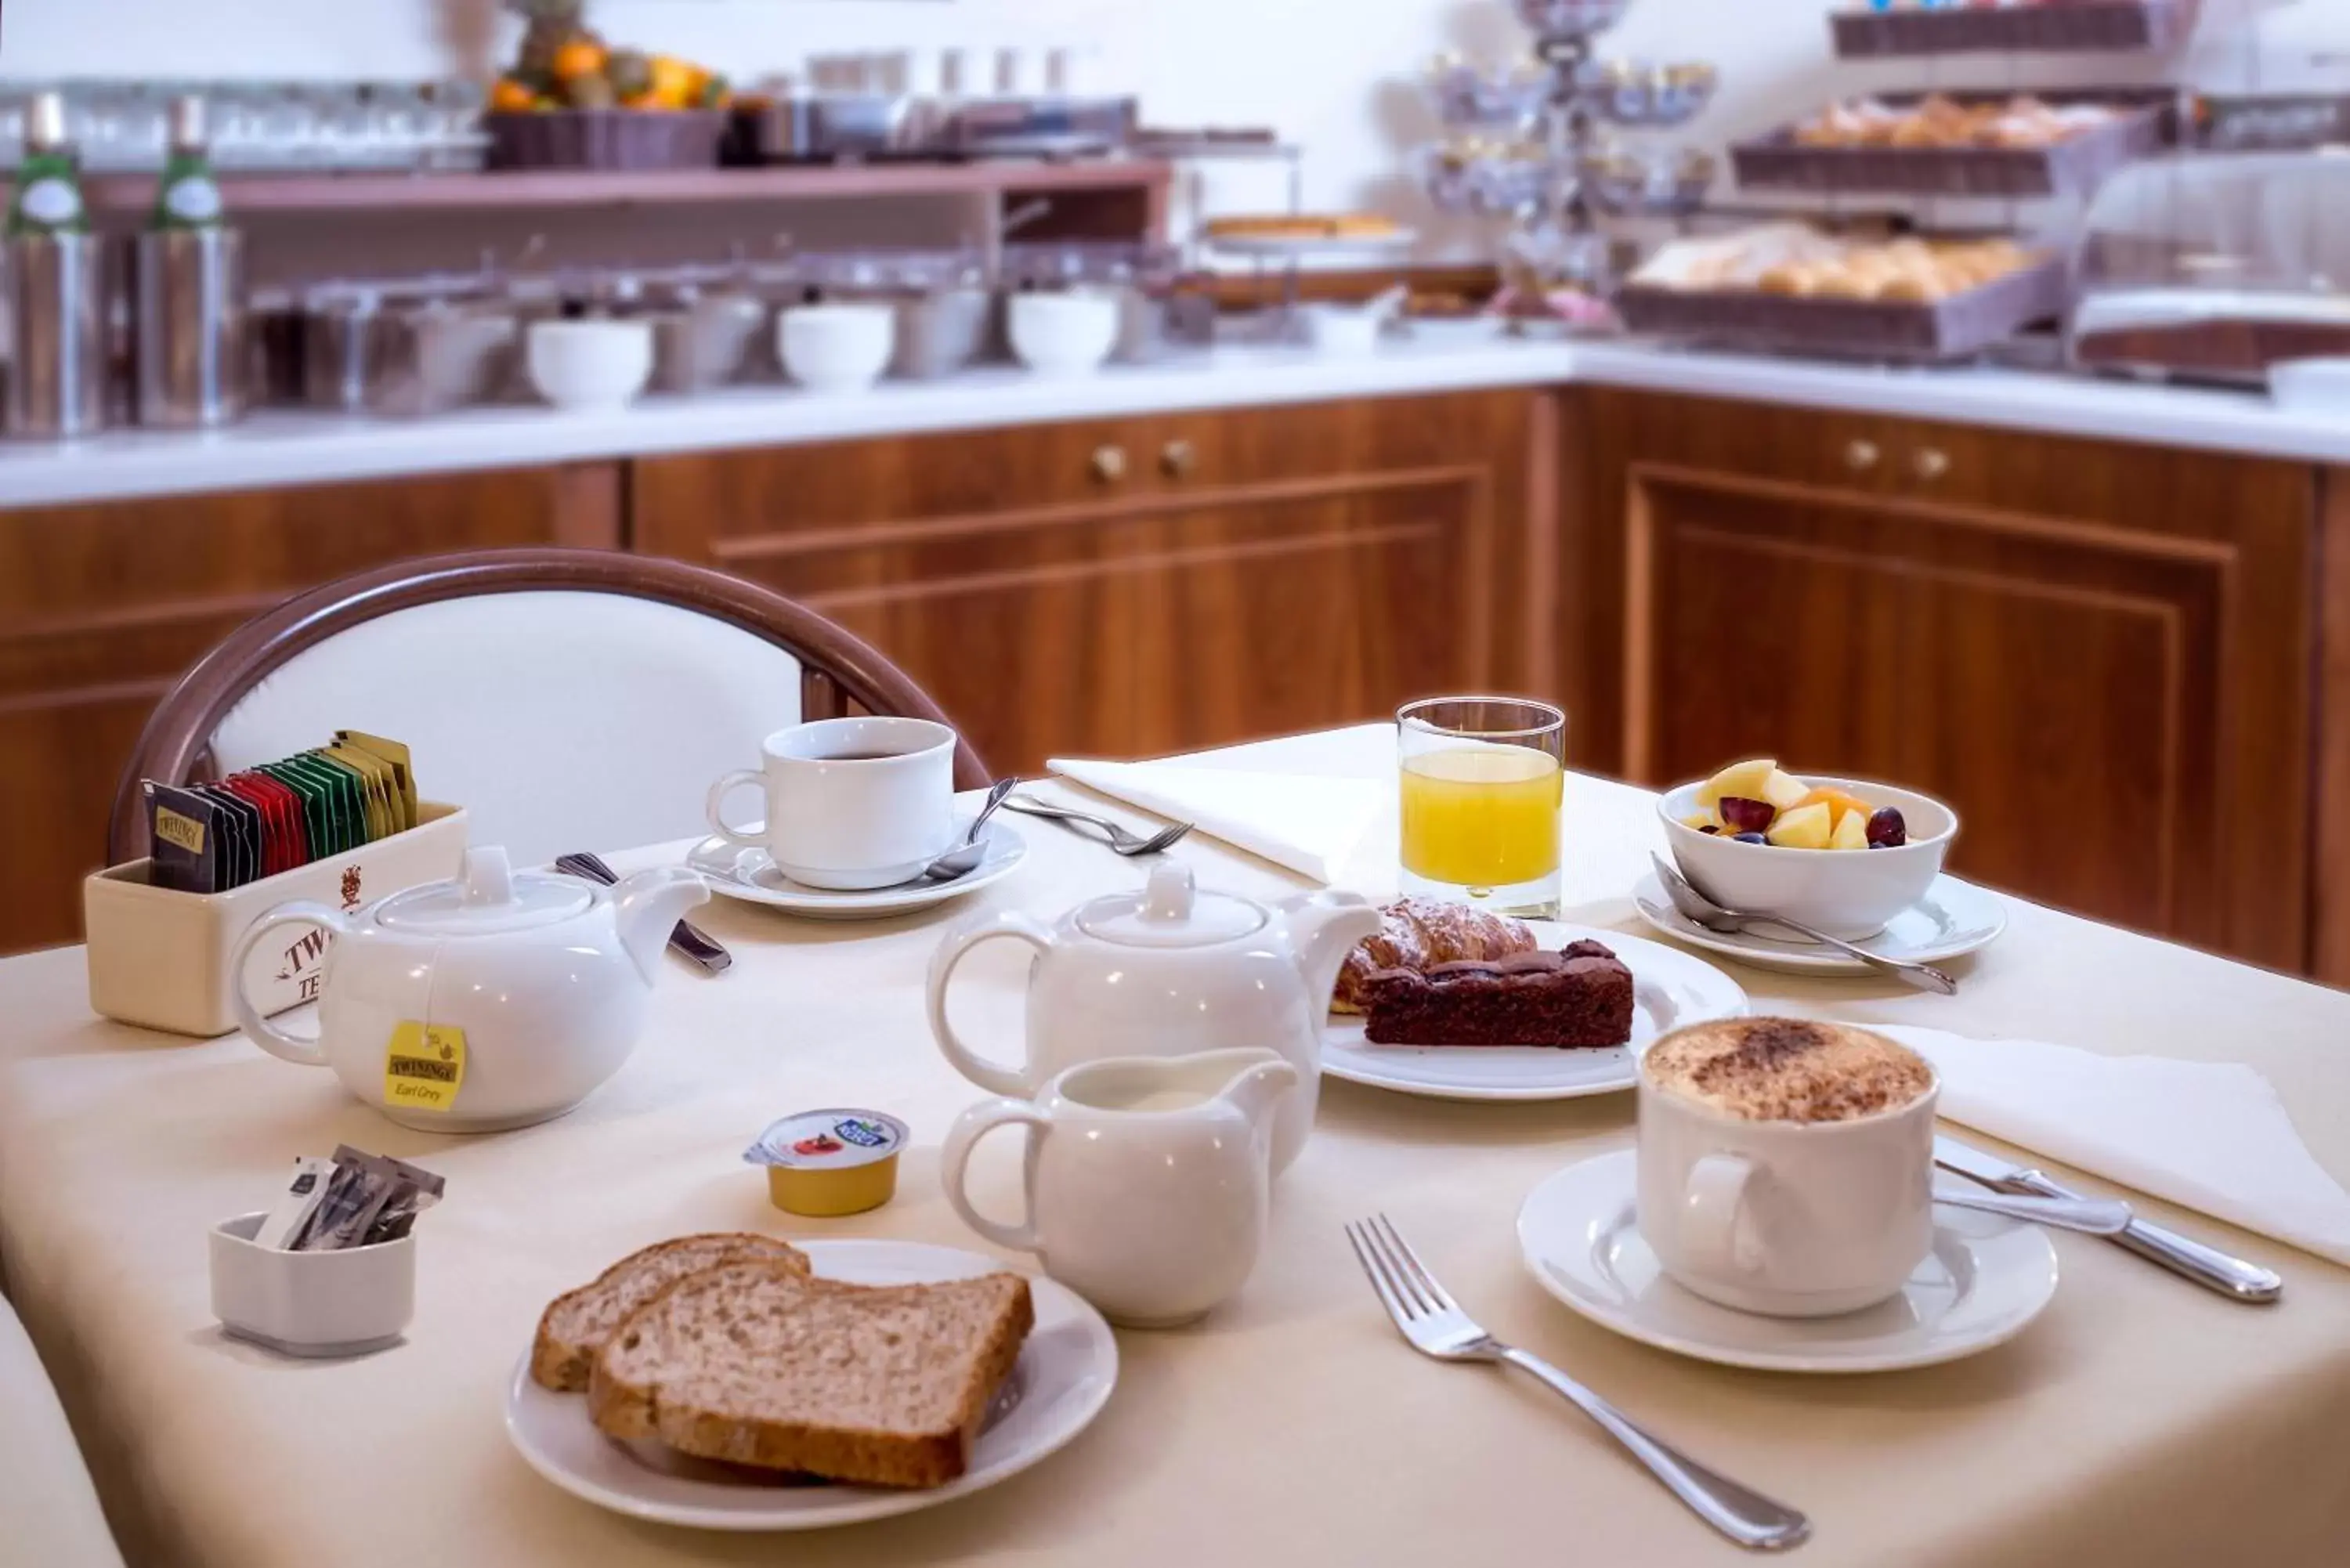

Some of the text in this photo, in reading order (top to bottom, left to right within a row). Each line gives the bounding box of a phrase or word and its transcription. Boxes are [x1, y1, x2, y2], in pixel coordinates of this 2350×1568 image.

[393, 1059, 452, 1081] TWININGS
[395, 1082, 441, 1103] Earl Grey
